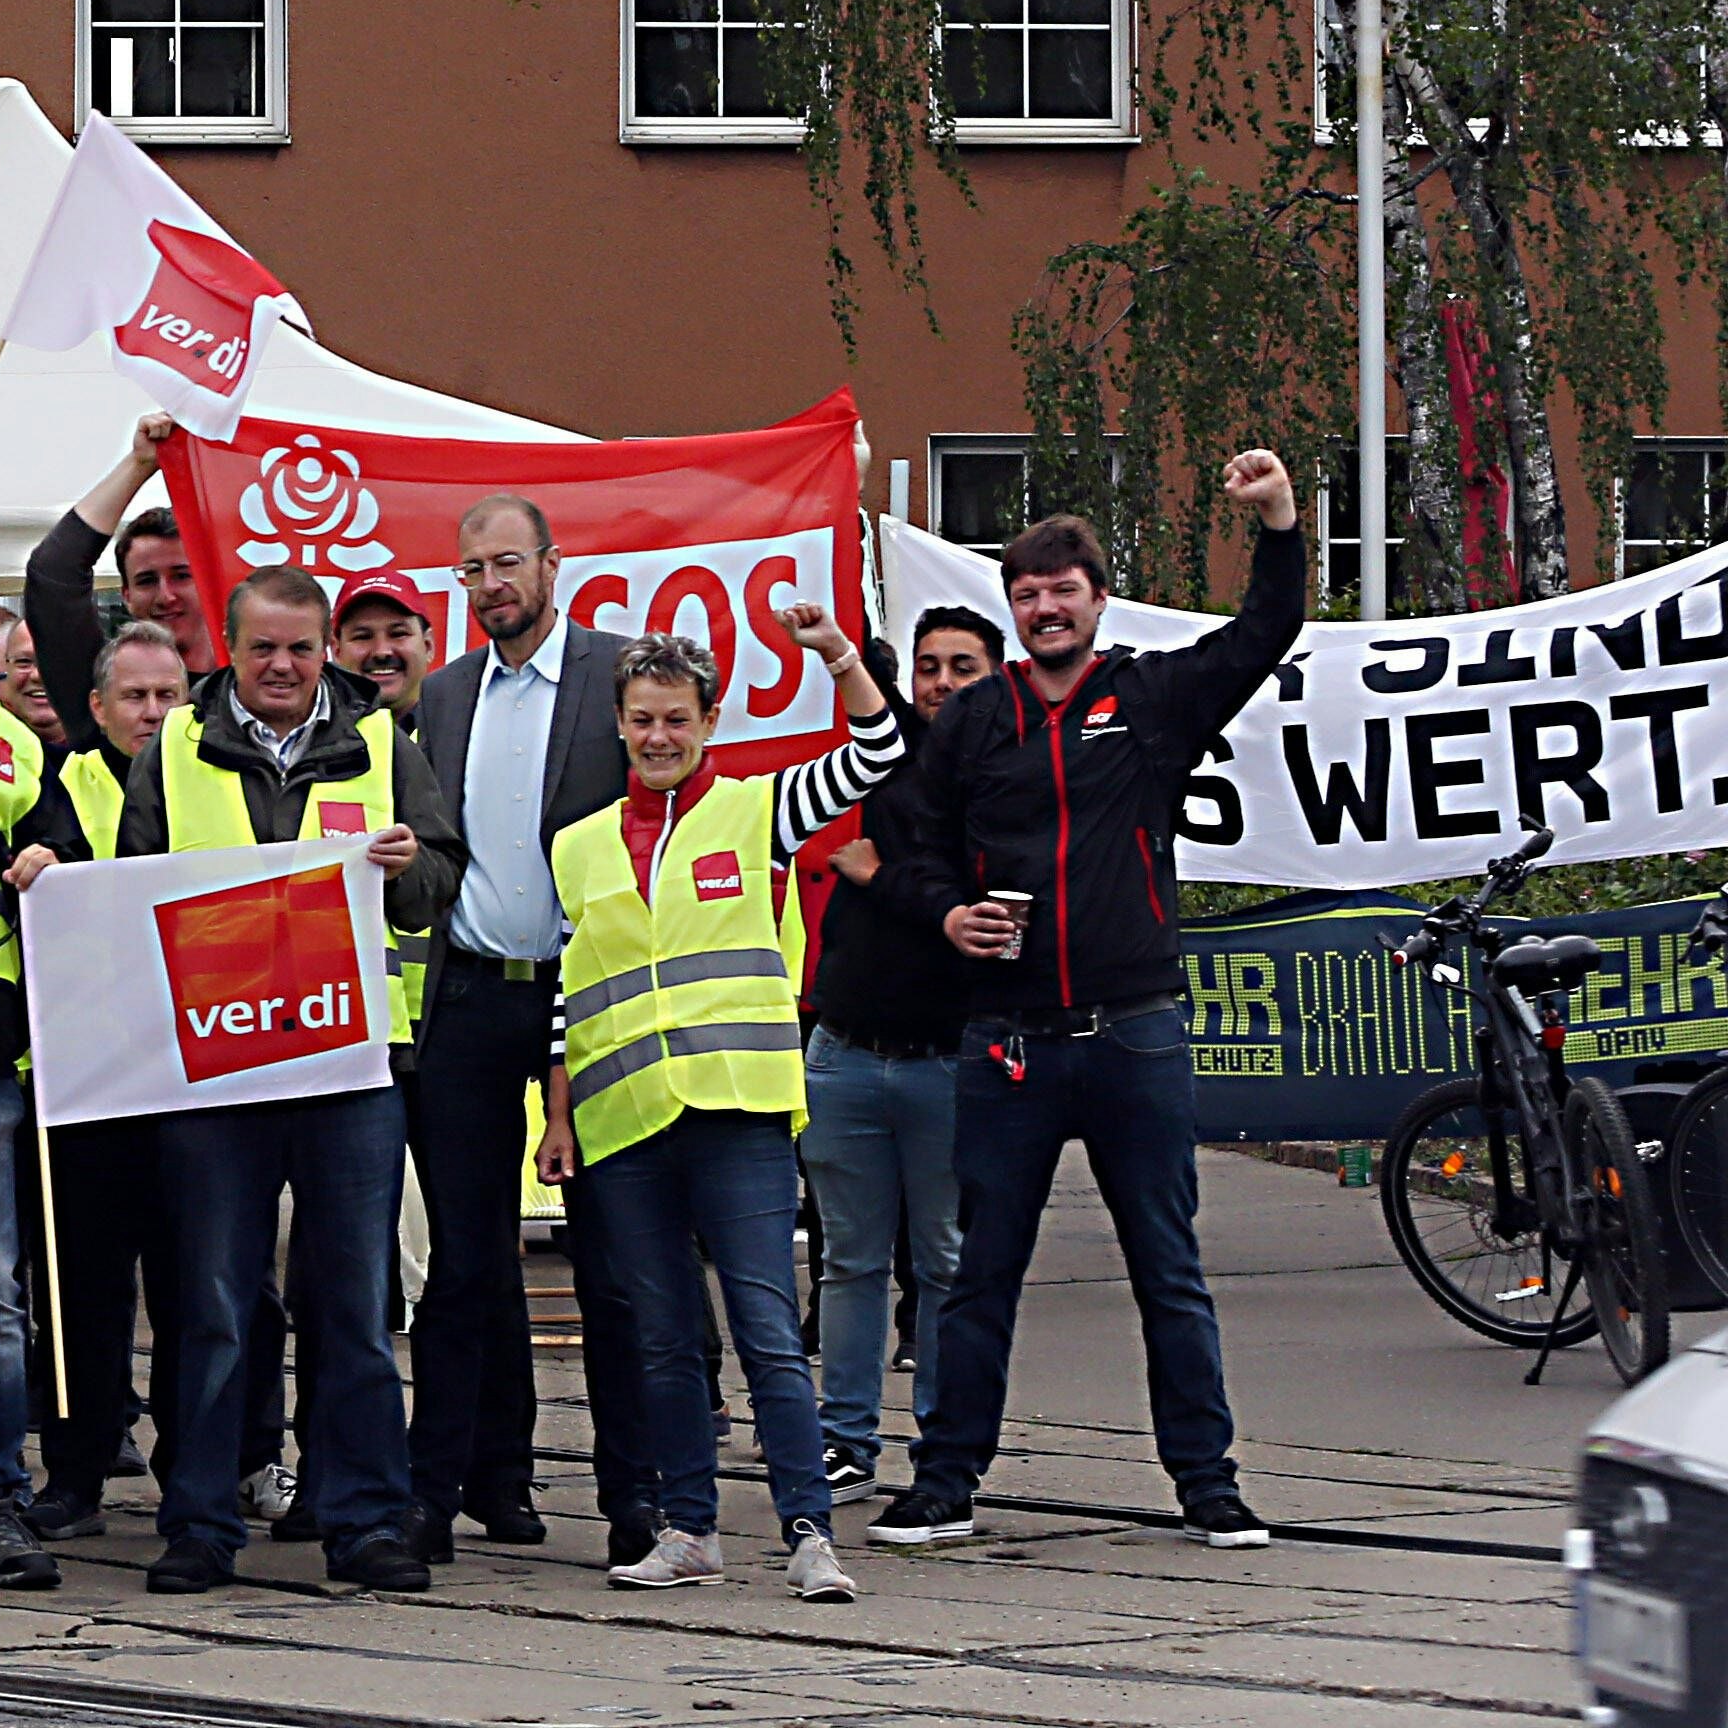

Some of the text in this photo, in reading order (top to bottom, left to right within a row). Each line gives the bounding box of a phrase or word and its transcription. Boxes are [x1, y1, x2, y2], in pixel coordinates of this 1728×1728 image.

[140, 303, 248, 380] ver.di
[696, 874, 740, 889] ver.di
[185, 981, 351, 1039] ver.di
[1295, 945, 1478, 1076] BRAUCH
